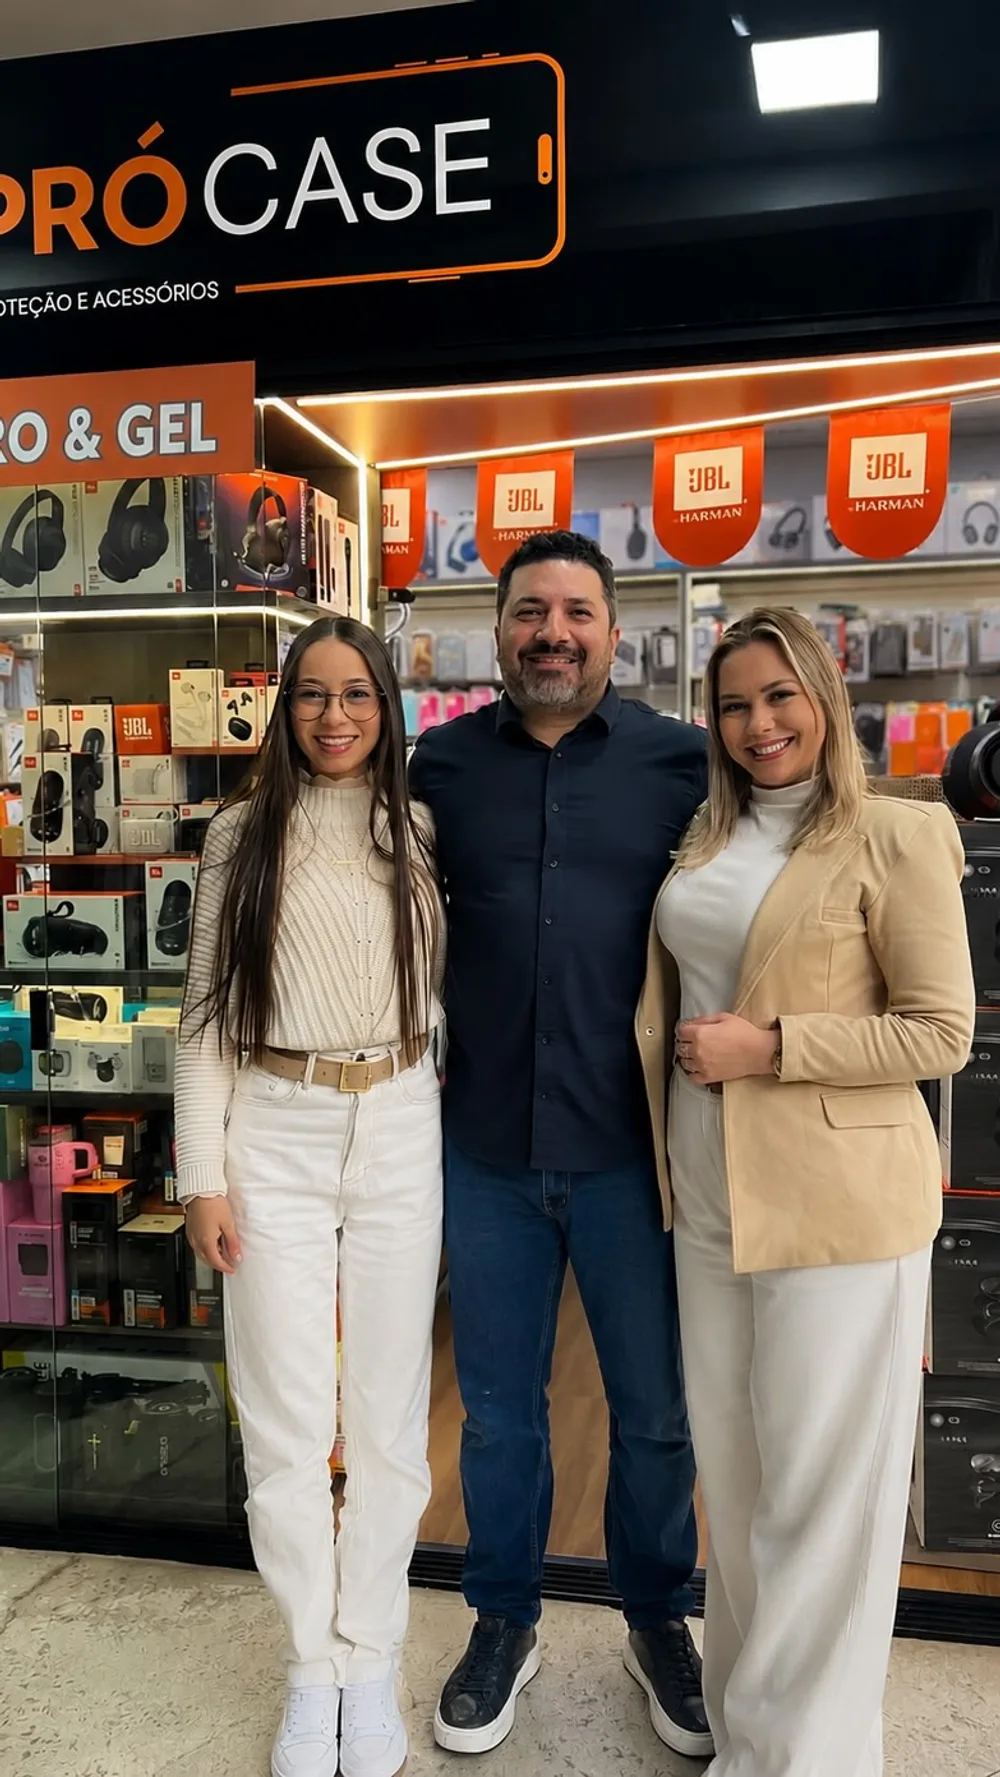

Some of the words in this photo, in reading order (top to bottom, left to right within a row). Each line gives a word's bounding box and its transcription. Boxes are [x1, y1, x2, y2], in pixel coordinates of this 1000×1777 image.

[204, 118, 492, 236] CASE
[78, 292, 88, 310] E
[93, 281, 219, 309] ACESSÓRIOS
[0, 410, 49, 464] O
[63, 406, 101, 462] &
[116, 400, 217, 458] GEL
[688, 465, 730, 493] JBL
[866, 451, 912, 480] JBL
[507, 487, 544, 512] JBL
[855, 498, 925, 512] HARMAN
[679, 506, 743, 523] HARMAN
[122, 716, 153, 736] JBL
